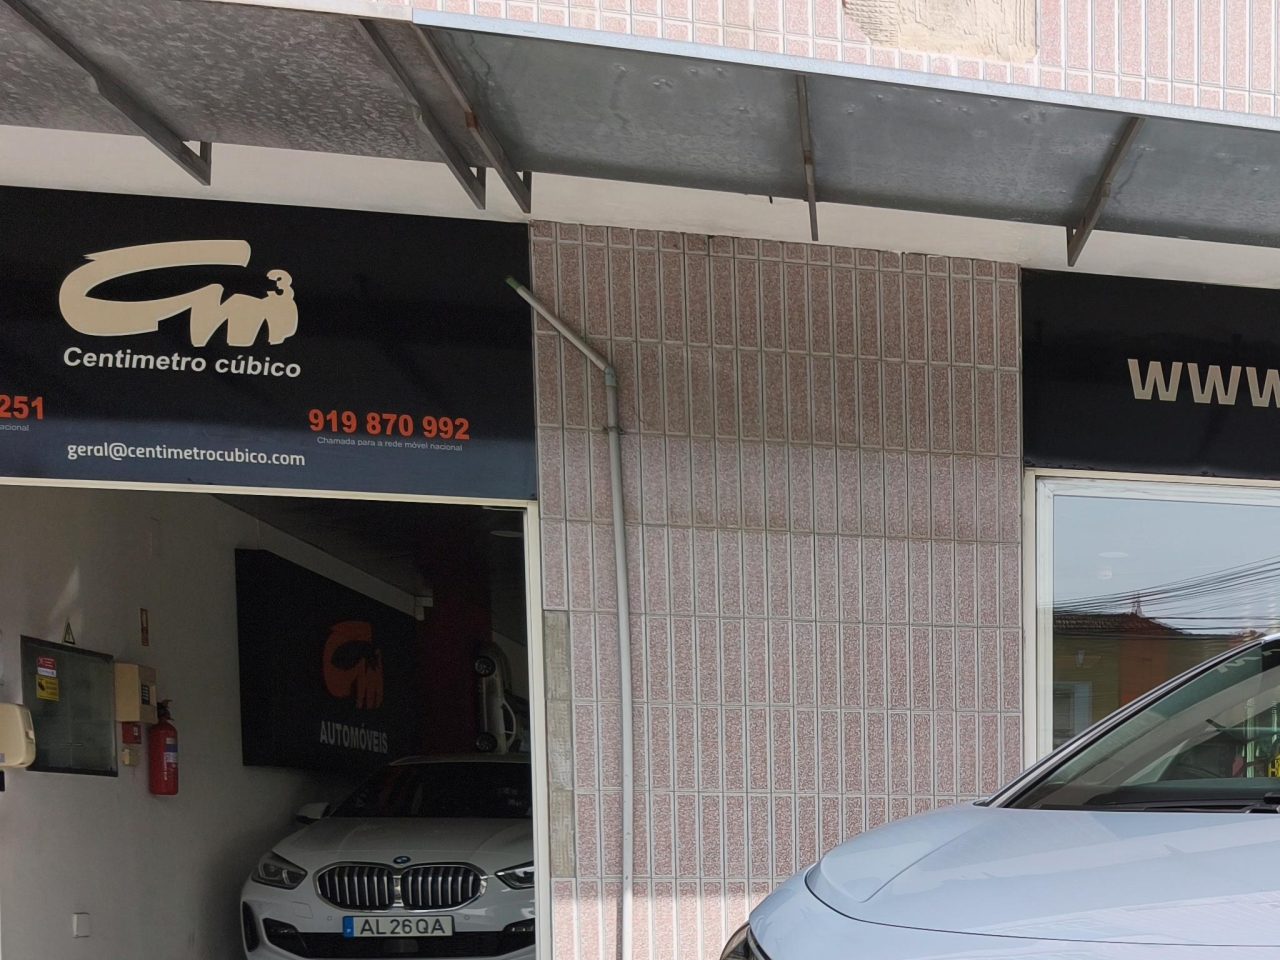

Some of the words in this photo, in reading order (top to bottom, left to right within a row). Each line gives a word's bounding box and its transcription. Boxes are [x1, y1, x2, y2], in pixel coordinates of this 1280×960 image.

[63, 347, 207, 372] Centimetro
[214, 355, 301, 378] cúbico
[308, 408, 357, 433] 919
[366, 412, 414, 436] 870
[422, 416, 470, 440] 992
[67, 442, 305, 466] geral@centimetrocubico.com
[316, 436, 356, 446] Chamada
[357, 440, 376, 448] para
[384, 440, 403, 448] rede
[404, 441, 428, 449] móvel
[430, 444, 463, 452] nacional
[320, 720, 389, 754] AUTOMÓVEIS
